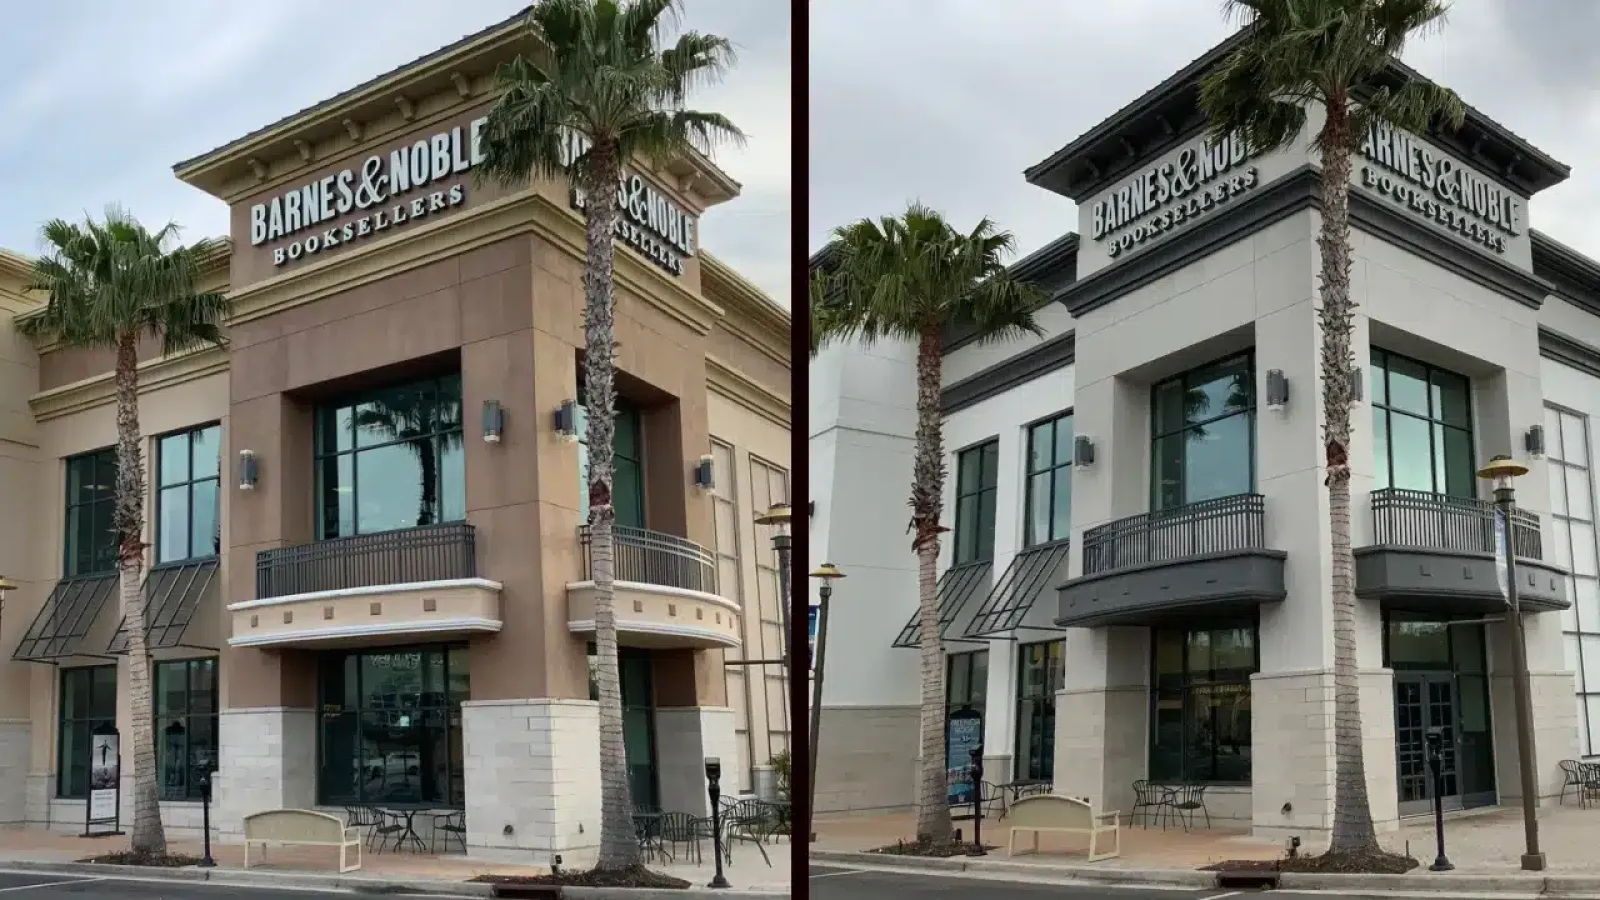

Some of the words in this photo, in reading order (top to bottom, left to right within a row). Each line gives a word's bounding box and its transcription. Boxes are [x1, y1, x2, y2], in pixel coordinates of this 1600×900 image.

[273, 184, 463, 266] BOOKSELLERS
[1108, 166, 1255, 256] BOOKSELLERS
[1367, 167, 1507, 252] BOOKSELLERS
